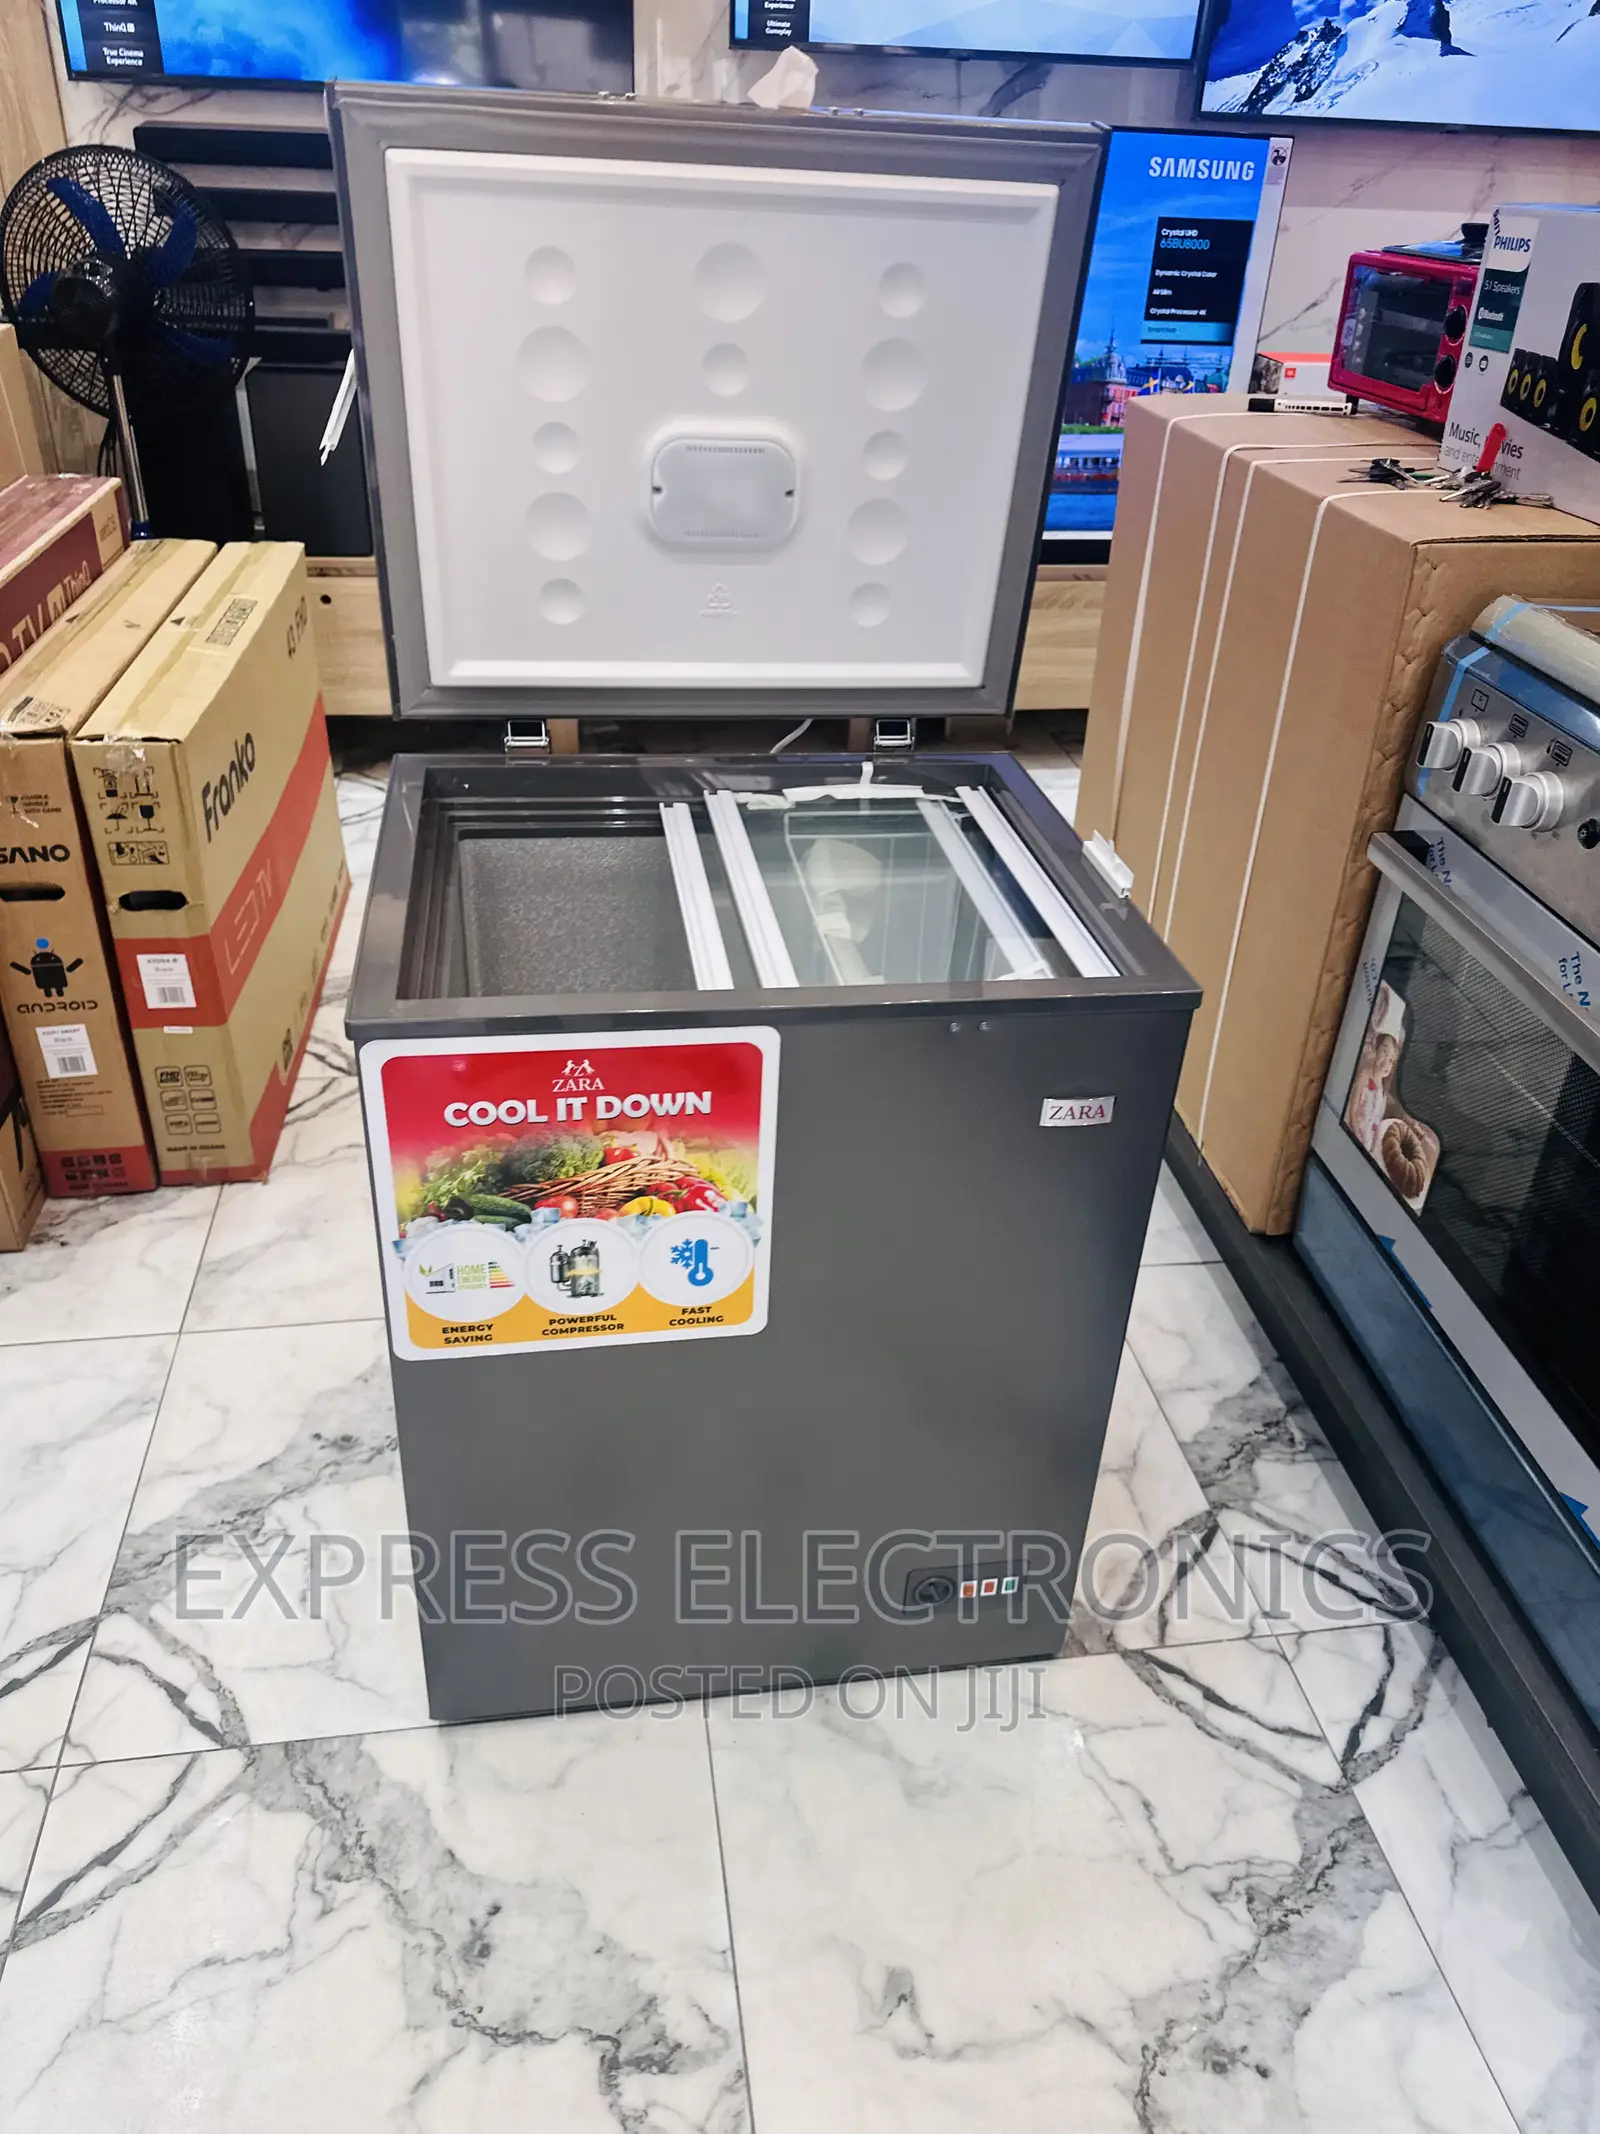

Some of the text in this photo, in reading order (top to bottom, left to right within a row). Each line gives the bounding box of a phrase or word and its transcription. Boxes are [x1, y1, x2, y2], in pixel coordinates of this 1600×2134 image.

[103, 22, 126, 33] ThinQ
[765, 28, 792, 36] Gameplay
[102, 47, 143, 57] True Cinema
[106, 57, 142, 66] Experience
[1149, 157, 1254, 181] SAMSUNG
[1161, 229, 1184, 237] Crystal
[1494, 235, 1531, 252] PHILIPS
[1493, 281, 1520, 295] Speakers
[1448, 422, 1480, 448] Music,
[1444, 445, 1460, 460] and
[202, 732, 255, 843] Franko
[1558, 957, 1568, 979] for
[1571, 951, 1583, 985] The
[552, 1077, 605, 1093] ZARA
[444, 1091, 712, 1128] COOL IT DOWN
[1049, 1103, 1105, 1120] ZARA
[457, 1264, 486, 1275] HOME
[681, 1306, 712, 1316] FAST
[549, 1314, 617, 1326] POWERFUL
[669, 1315, 724, 1327] COOLING
[442, 1324, 493, 1334] ENERGY
[541, 1323, 625, 1336] COMPRESSOR
[444, 1334, 493, 1344] SAVING
